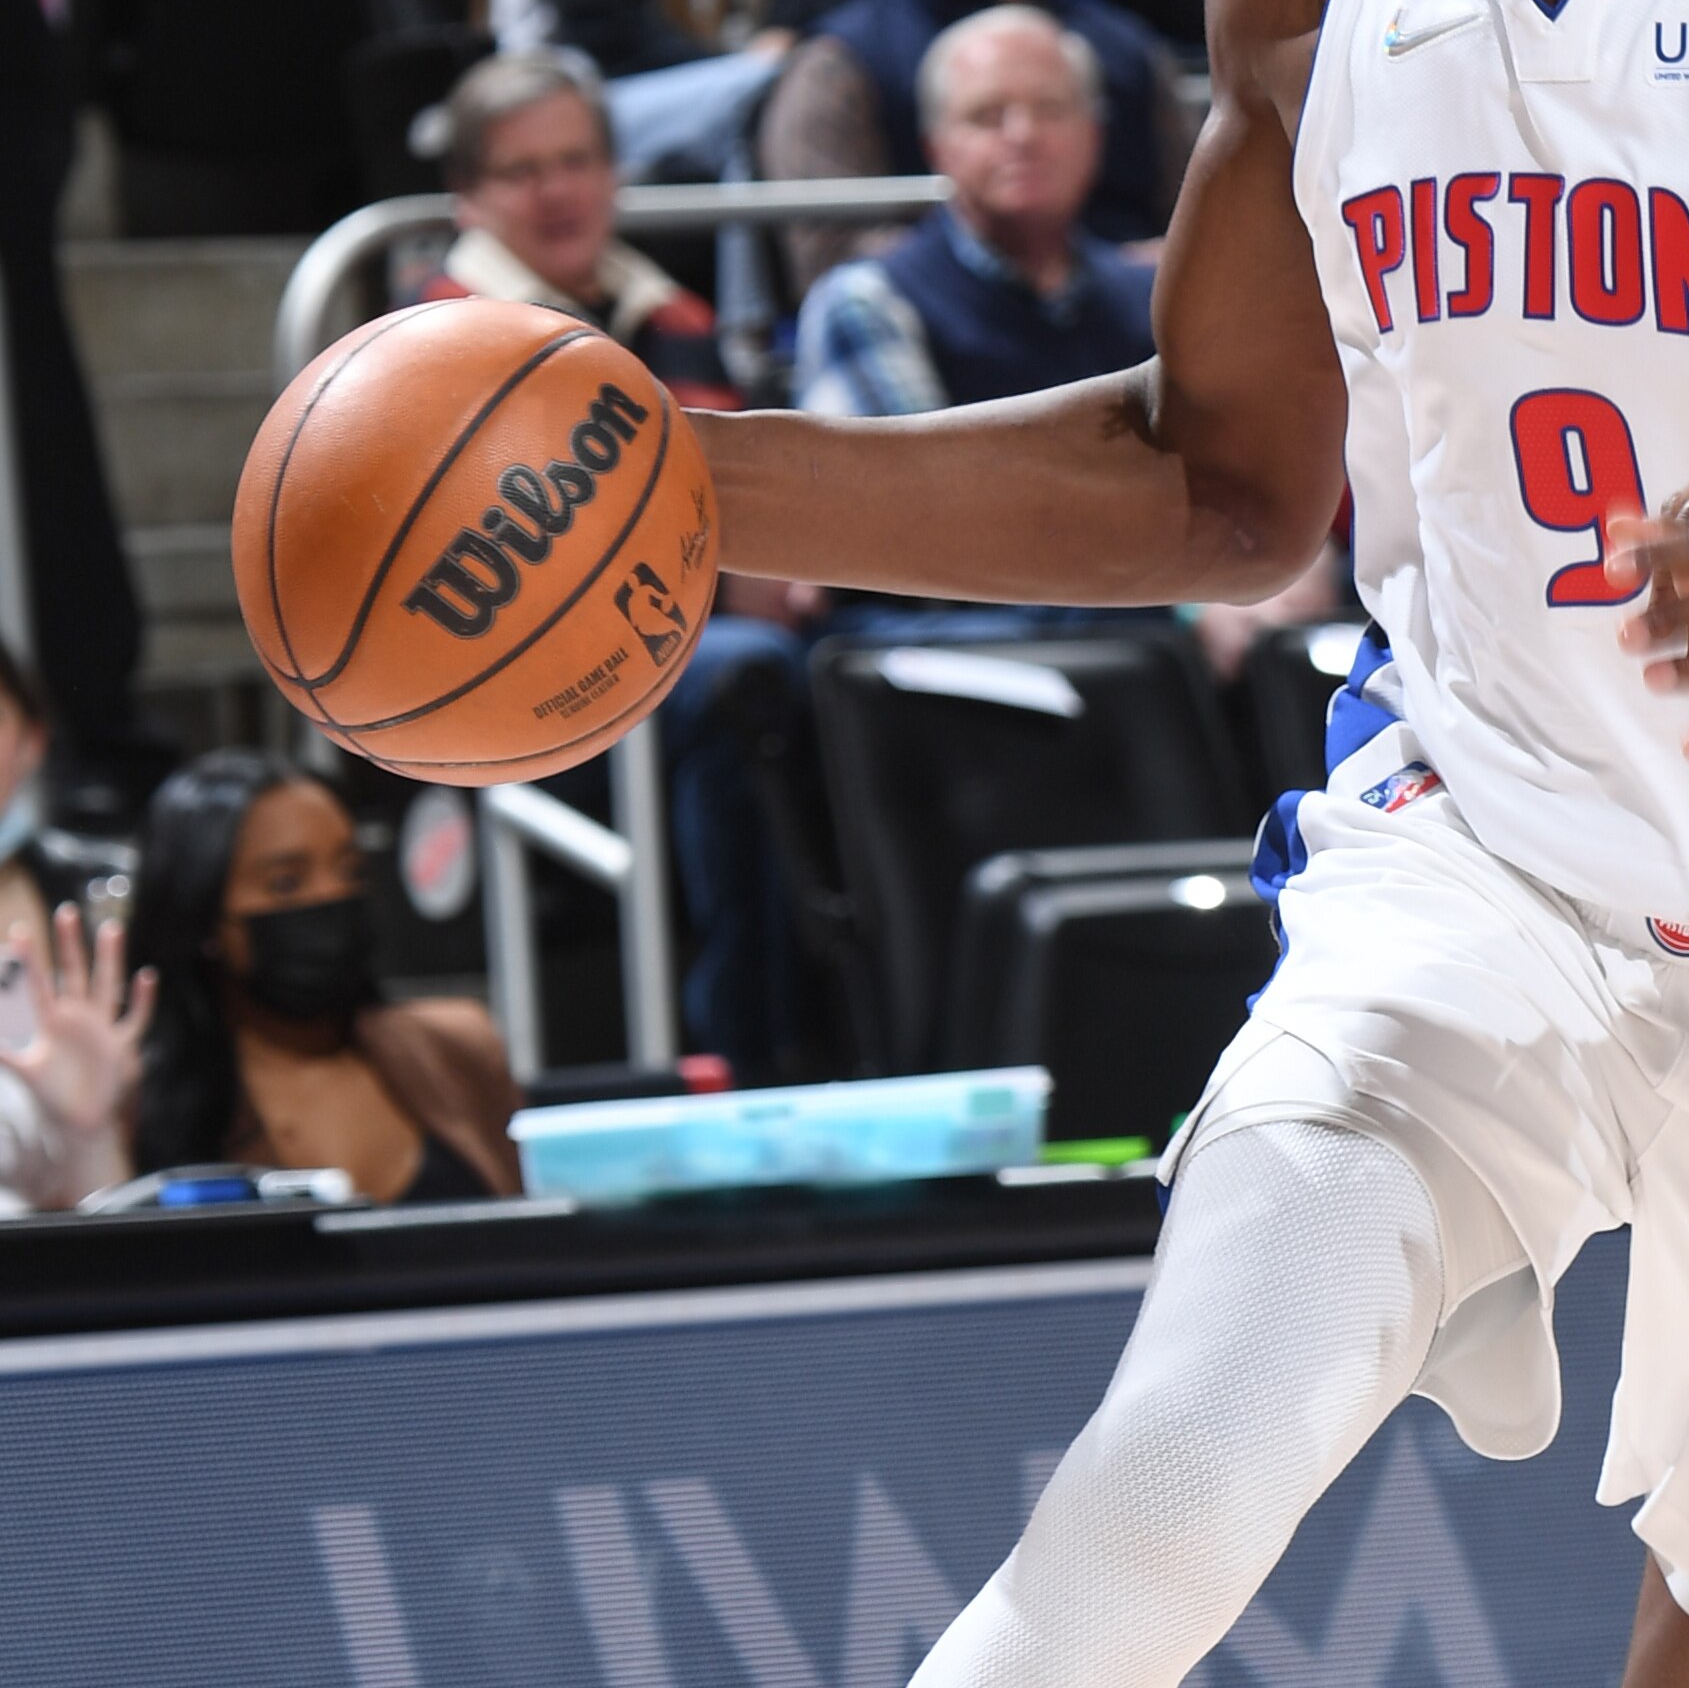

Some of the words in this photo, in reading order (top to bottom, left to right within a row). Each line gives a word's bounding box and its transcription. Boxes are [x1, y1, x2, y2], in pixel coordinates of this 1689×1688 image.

[400, 382, 648, 640] Wilson
[1510, 387, 1654, 608] 9
[532, 686, 580, 719] OFFICIAL
[577, 665, 607, 692] GAME
[603, 647, 630, 672] BALL
